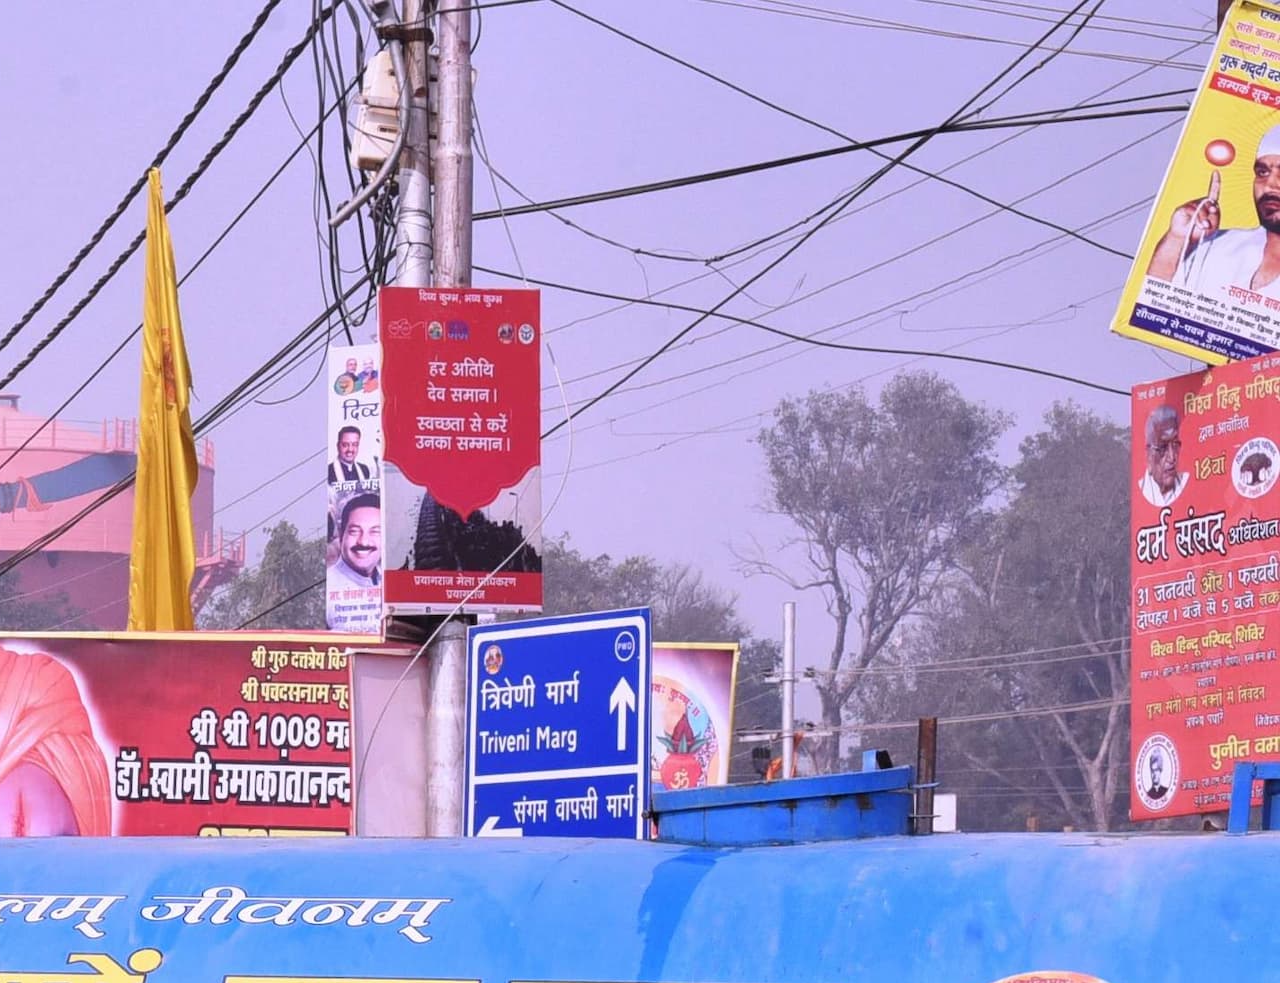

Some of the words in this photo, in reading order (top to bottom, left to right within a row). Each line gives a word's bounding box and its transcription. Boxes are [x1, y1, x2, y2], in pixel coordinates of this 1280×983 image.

[451, 357, 495, 378] अतिथि
[427, 382, 446, 402] देव
[1183, 393, 1212, 416] विश्व
[1216, 384, 1242, 412] हिन्दू
[416, 414, 465, 434] स्वच्छता
[469, 414, 483, 433] से
[486, 415, 508, 433] करें
[415, 434, 451, 451] उनका
[1136, 506, 1172, 562] धर्म
[1174, 507, 1227, 558] संसद
[1228, 511, 1280, 546] अधिवेशन
[413, 575, 453, 586] प्रयागराज
[1153, 570, 1196, 602] जनवरी
[1201, 570, 1225, 594] और
[1238, 555, 1280, 586] फरवरी
[251, 645, 267, 669] श्री
[1150, 638, 1174, 658] विश्व
[1175, 635, 1201, 657] हिन्दू
[241, 676, 259, 702] श्री
[481, 674, 536, 712] त्रिवेणी
[545, 671, 580, 705] मार्ग
[191, 709, 217, 747] श्री
[222, 709, 250, 747] श्री
[254, 715, 321, 748] 1008
[479, 726, 530, 754] Triveni
[536, 726, 578, 753] Marg
[1209, 734, 1250, 771] पुनीत
[513, 796, 548, 824] संगम
[555, 787, 598, 822] वापसी
[606, 785, 635, 818] मार्ग
[140, 885, 453, 944] जीवनम्
